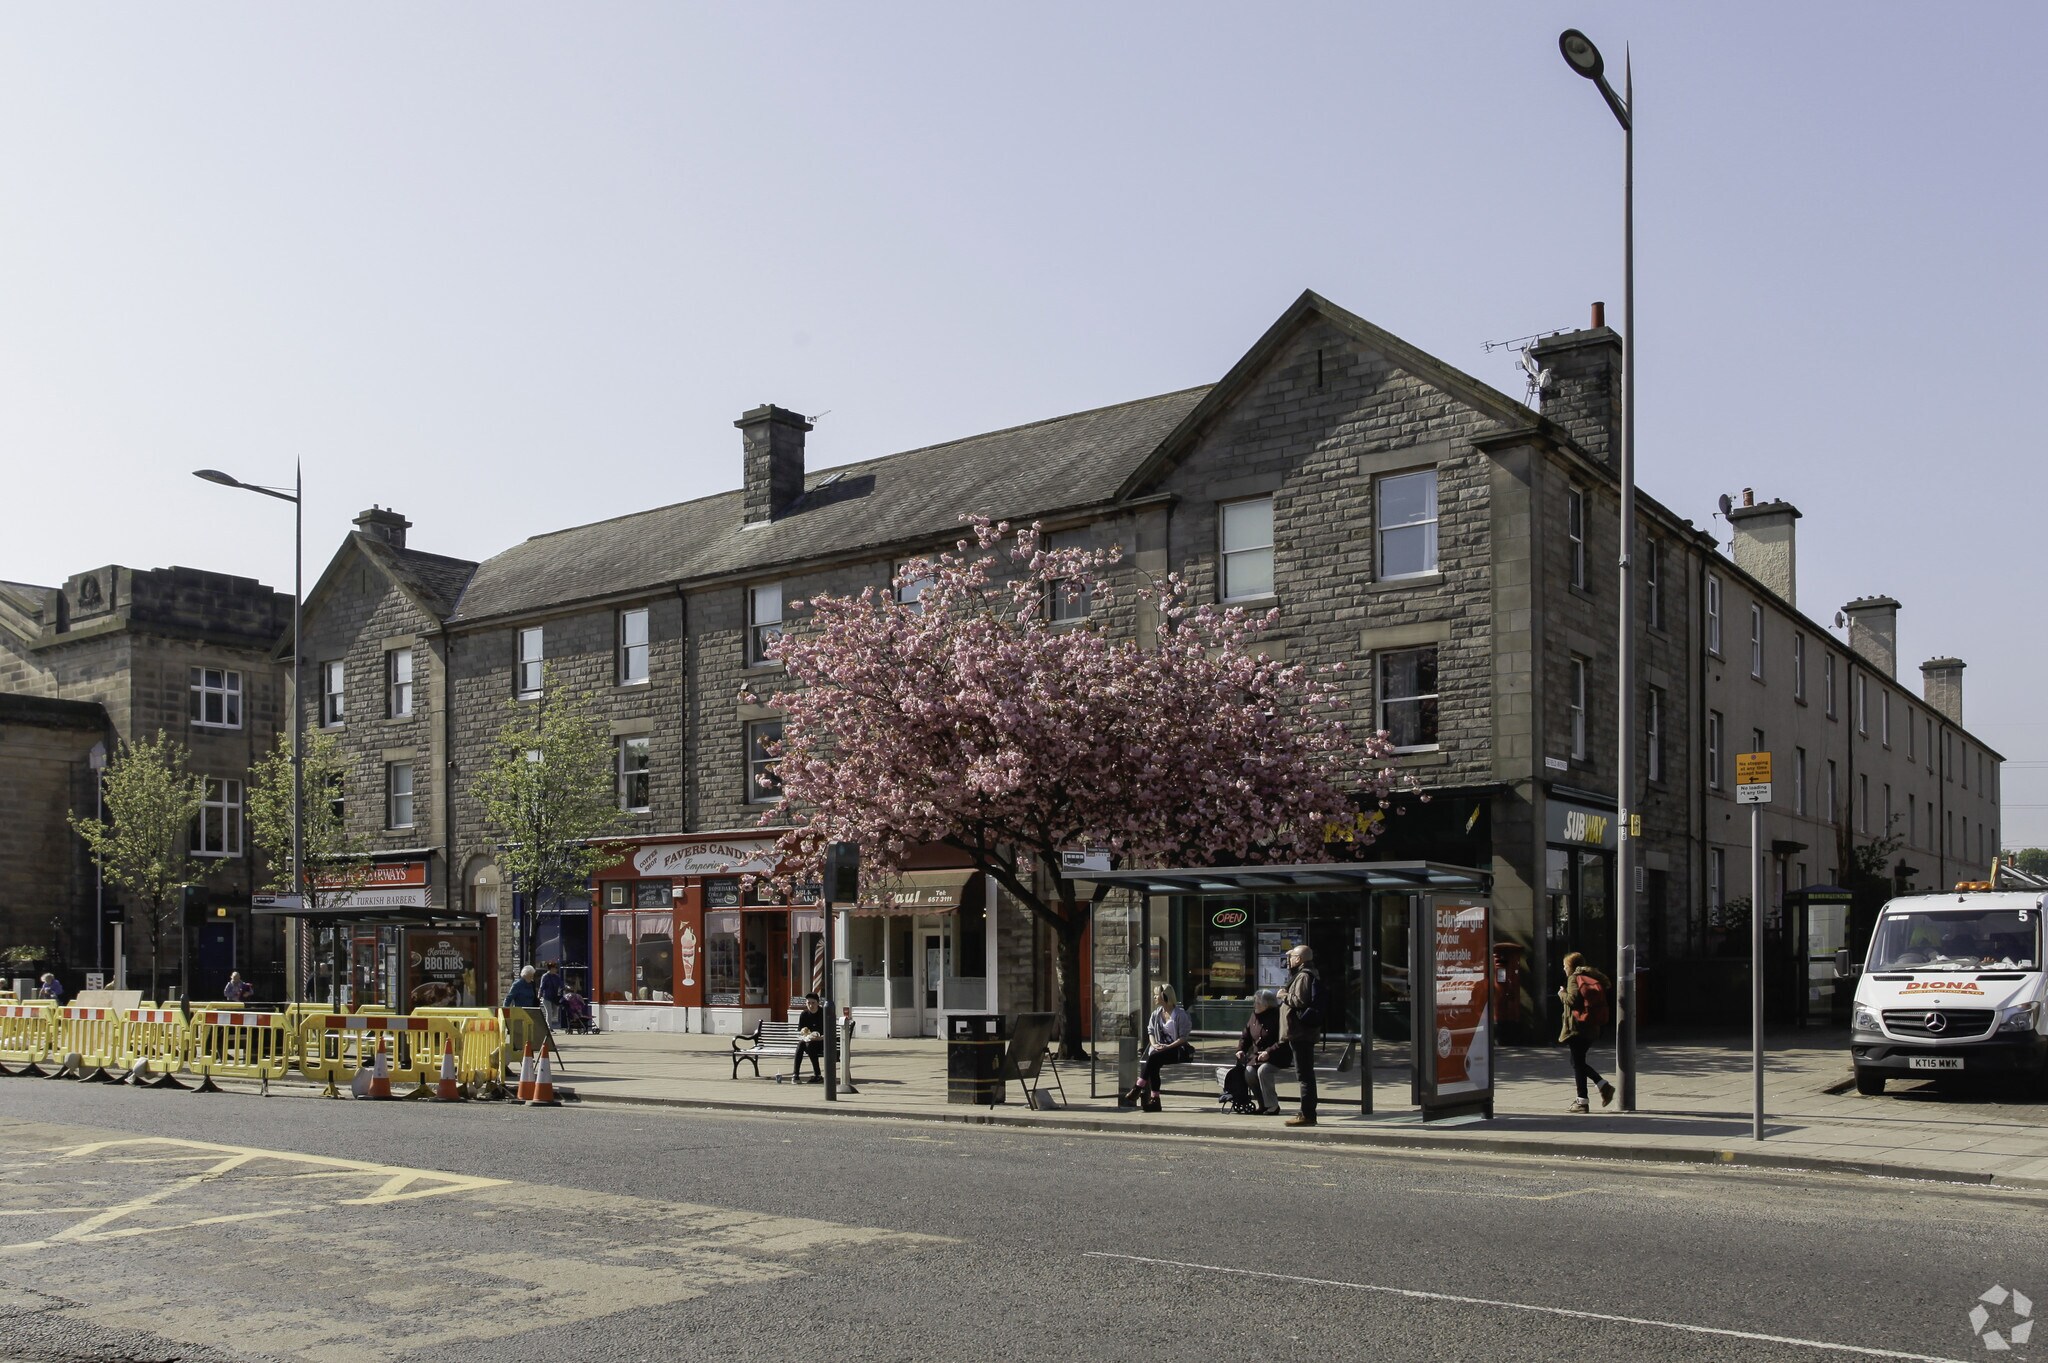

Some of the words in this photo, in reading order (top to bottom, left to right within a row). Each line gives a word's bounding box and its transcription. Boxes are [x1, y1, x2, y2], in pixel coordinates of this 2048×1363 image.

[1563, 810, 1608, 844] SUBWAY
[639, 848, 658, 869] COFFEE
[664, 844, 706, 867] FAVERS
[644, 858, 658, 872] SHOP
[684, 858, 726, 873] Emporiu
[356, 897, 384, 906] TURKISH
[386, 895, 416, 905] BARBERS
[1216, 912, 1242, 923] OPEN
[1436, 910, 1483, 933] Edinburgh!
[2018, 910, 2028, 922] 5
[1448, 934, 1460, 944] our
[428, 947, 460, 958] Kentucky
[1436, 948, 1472, 960] unbeatable
[424, 957, 443, 970] BBQ
[444, 957, 464, 970] RIBS
[1906, 982, 1978, 990] DIONA
[1915, 1058, 1936, 1068] KT15
[1938, 1058, 1958, 1068] MWK
